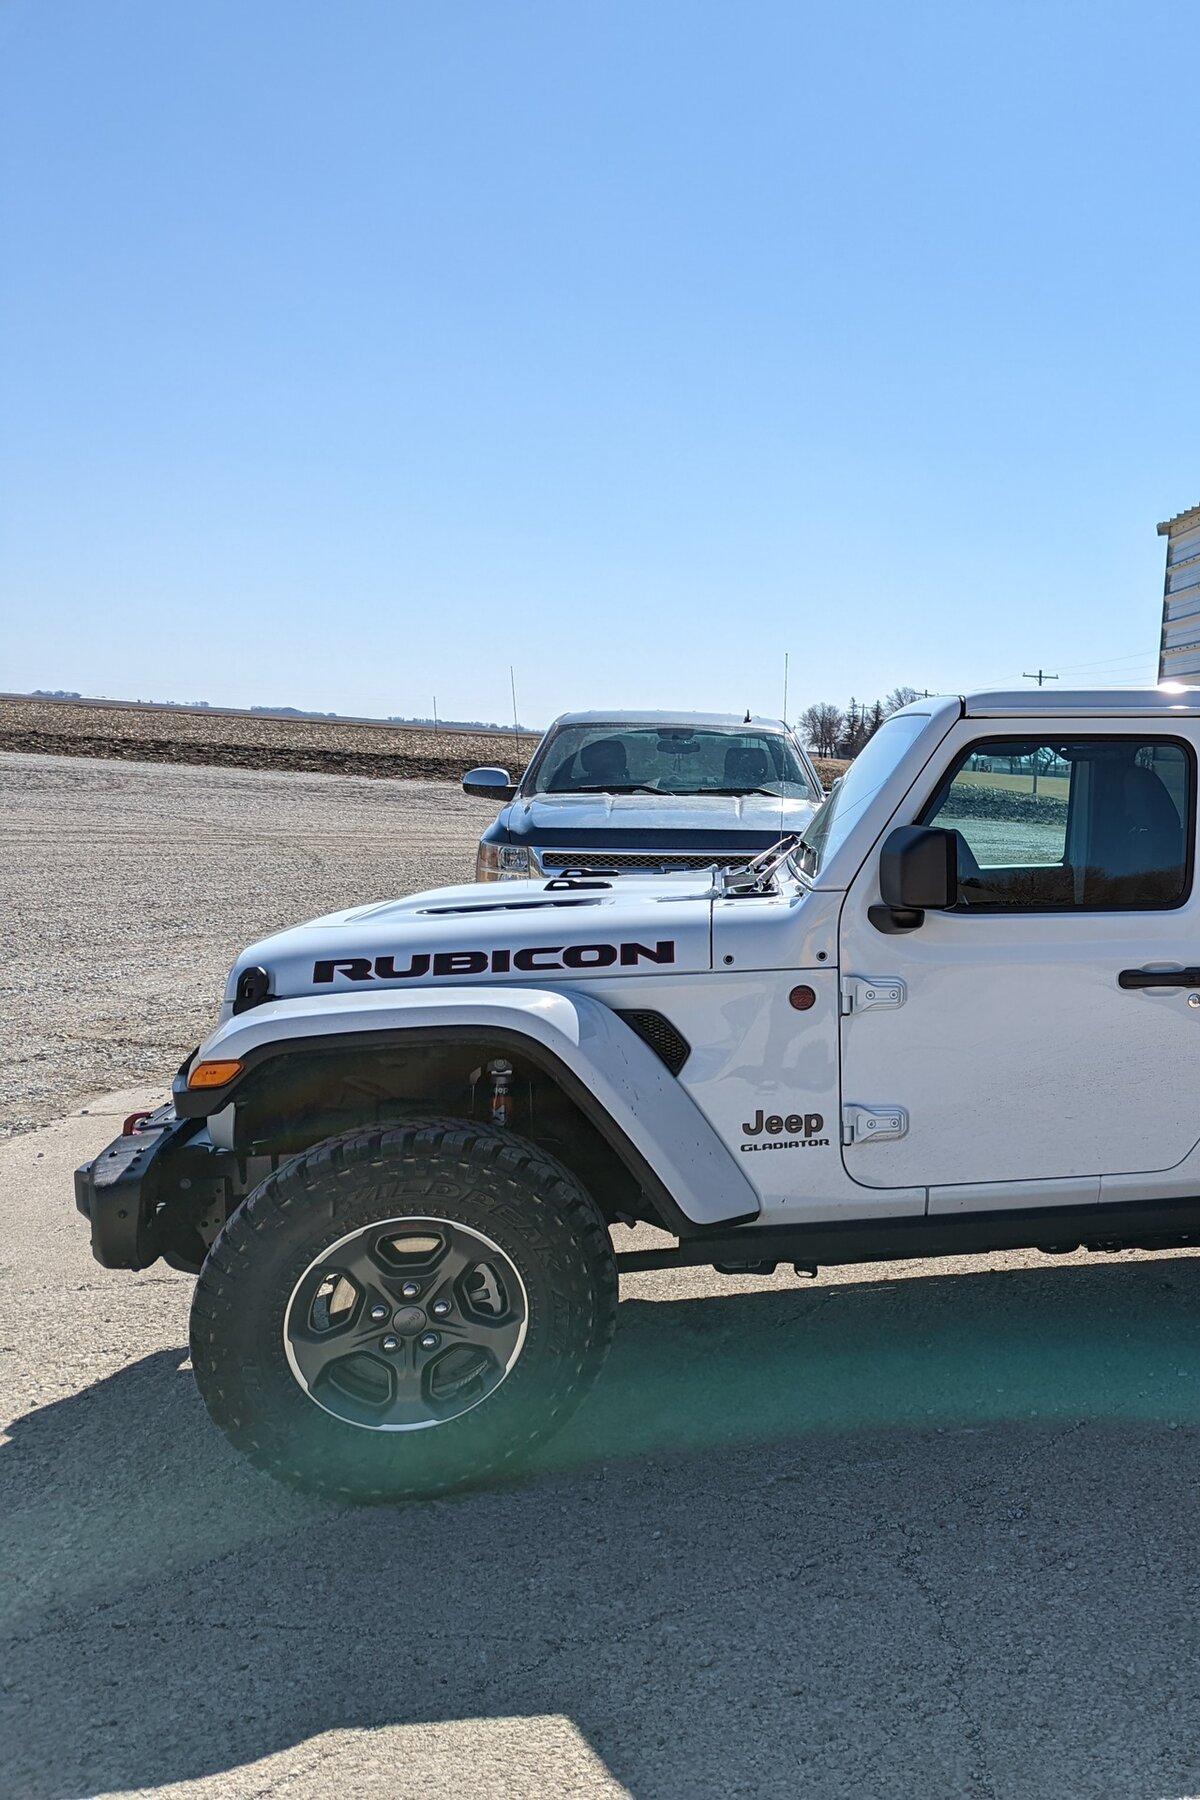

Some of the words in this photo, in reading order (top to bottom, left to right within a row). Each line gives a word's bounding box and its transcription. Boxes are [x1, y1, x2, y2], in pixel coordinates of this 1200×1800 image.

[312, 940, 675, 984] RUBICON
[742, 1110, 824, 1138] Jeep
[740, 1139, 830, 1152] GLADIATOR
